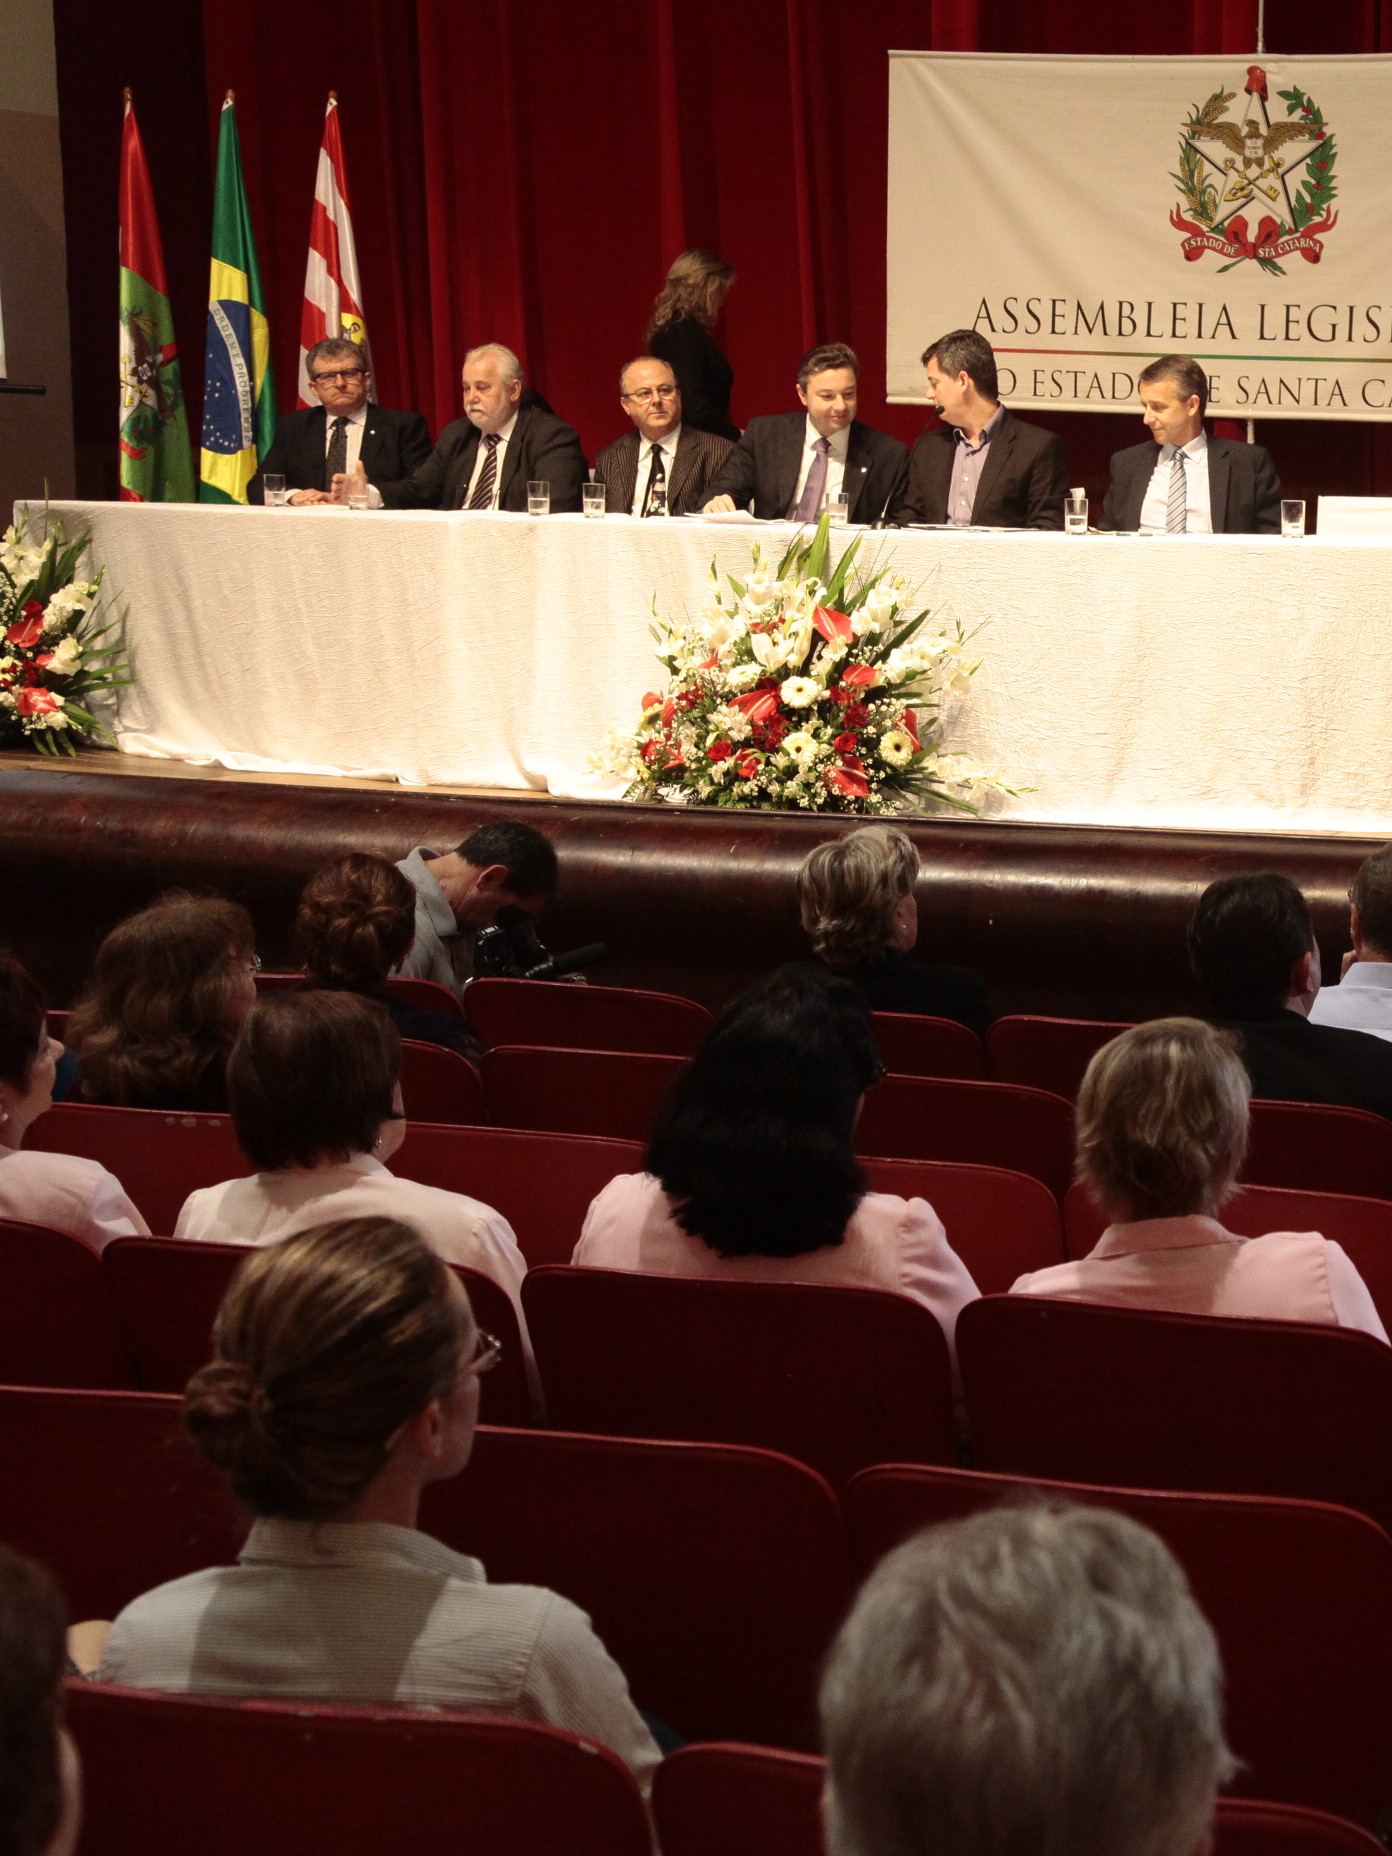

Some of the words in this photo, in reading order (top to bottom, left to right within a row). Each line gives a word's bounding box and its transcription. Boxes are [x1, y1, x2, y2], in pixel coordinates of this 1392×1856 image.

[1184, 237, 1223, 251] ESTADO
[1223, 245, 1237, 256] DE
[1278, 237, 1320, 254] CATARINA
[213, 308, 237, 351] ORDEM
[972, 296, 1239, 340] ASSEMBLEIA
[1033, 369, 1134, 400] ESTAD
[1207, 375, 1220, 403] E
[1236, 375, 1349, 408] SANTA
